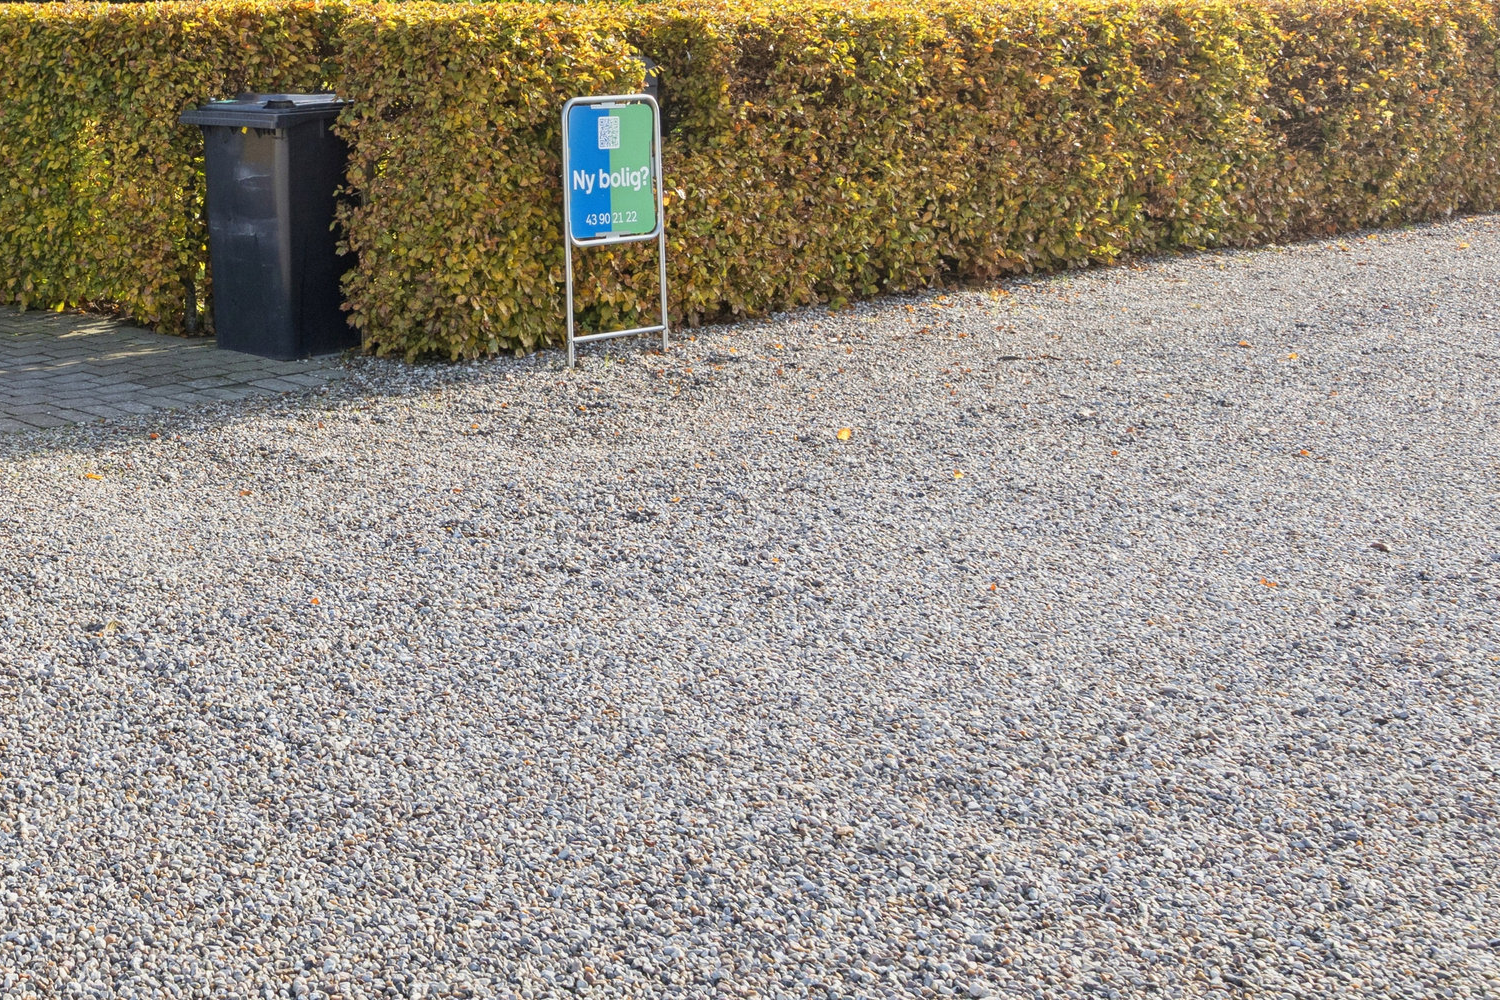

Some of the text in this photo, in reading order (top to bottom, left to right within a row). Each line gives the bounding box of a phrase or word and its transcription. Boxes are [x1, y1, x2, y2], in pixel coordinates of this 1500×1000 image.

[573, 166, 650, 194] Ny bolig?
[586, 210, 638, 226] 43 90 21 22
